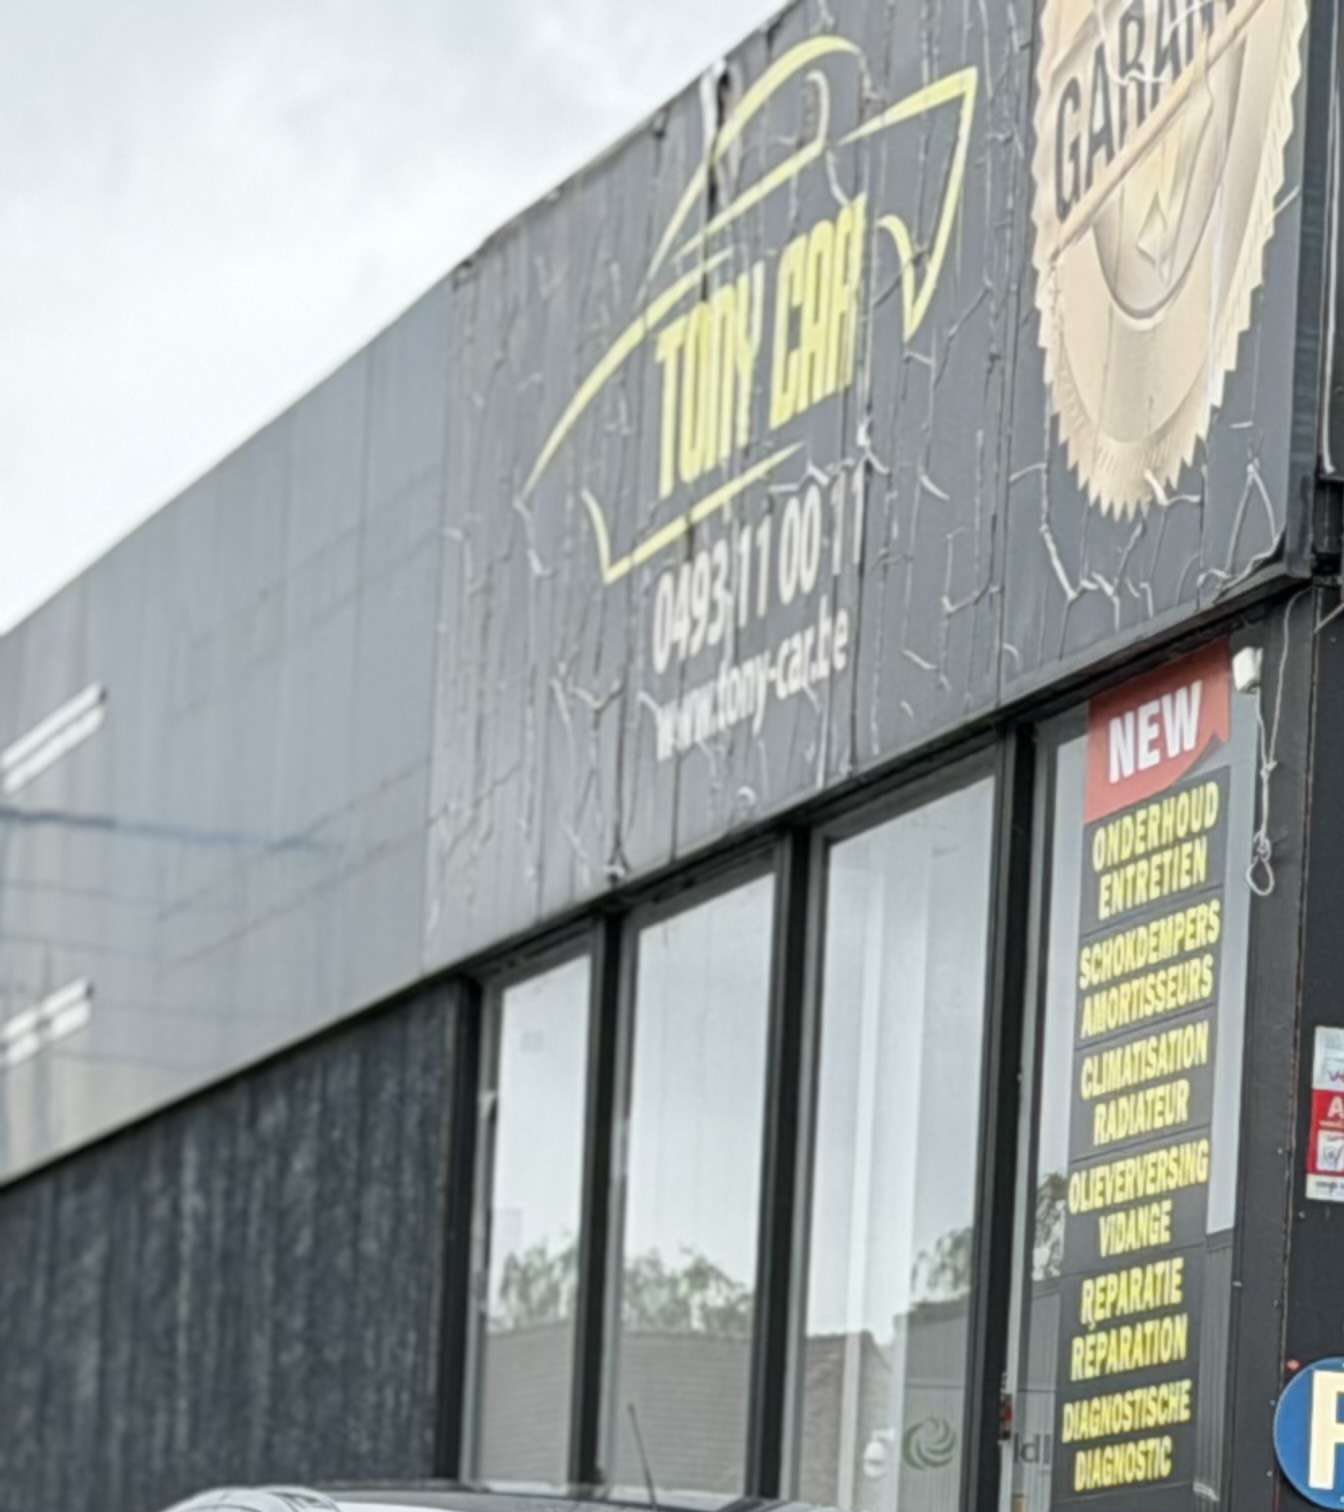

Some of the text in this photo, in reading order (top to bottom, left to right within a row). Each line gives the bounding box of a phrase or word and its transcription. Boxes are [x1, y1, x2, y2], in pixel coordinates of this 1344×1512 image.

[656, 191, 867, 499] TONY CAR
[653, 540, 728, 674] 0493
[778, 484, 822, 606] 00
[656, 594, 849, 762] www.tony-car.be
[1109, 680, 1203, 784] NEW
[1092, 781, 1220, 873] ONDERHOUD
[1098, 835, 1208, 921] ENTRETIEN
[1079, 899, 1222, 991] SCHOKDEMPERS
[1080, 953, 1214, 1040] AMORTISSEURS
[1080, 1019, 1210, 1101] CLIMATISATION
[1093, 1079, 1190, 1147] RADIATEUR
[1099, 1199, 1173, 1257] VIDANGE
[1080, 1256, 1184, 1325] REPARATIE
[1061, 1378, 1193, 1444] DIAGNOSTISCHE
[1074, 1436, 1173, 1492] DIAGNOSTIC
